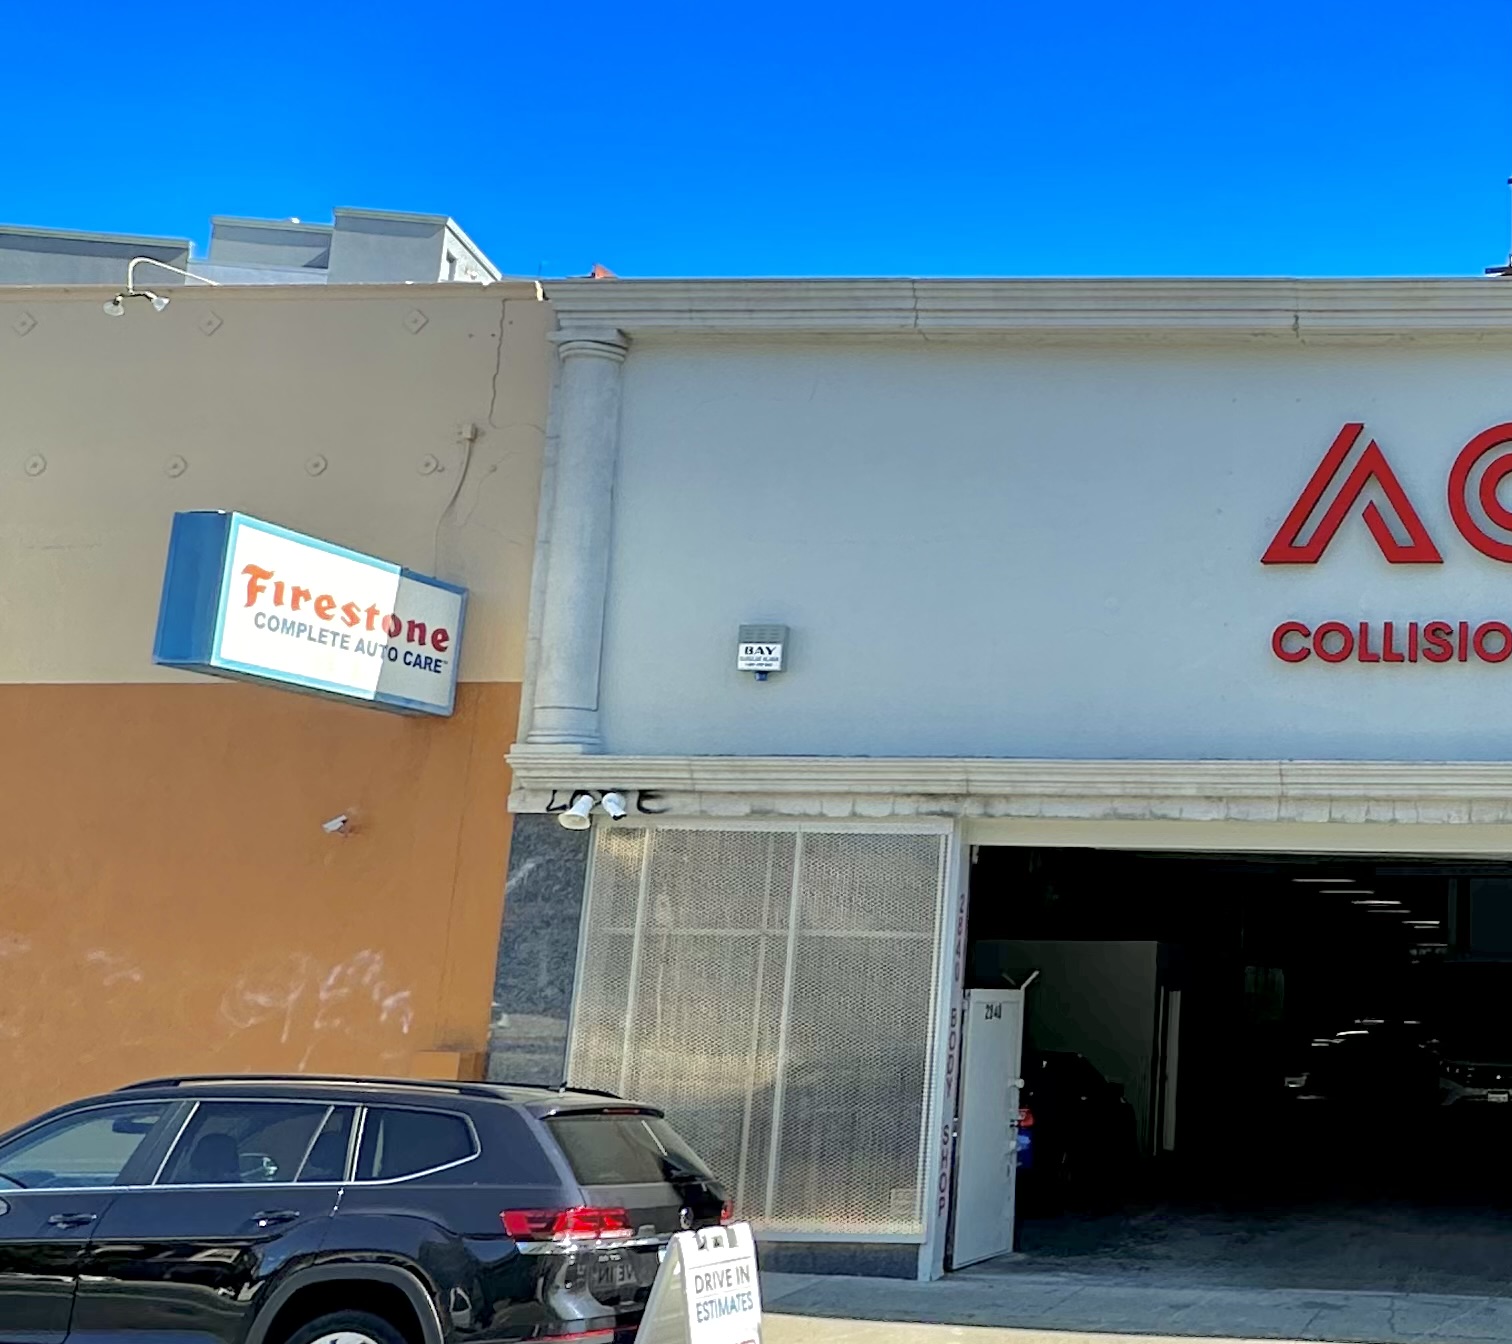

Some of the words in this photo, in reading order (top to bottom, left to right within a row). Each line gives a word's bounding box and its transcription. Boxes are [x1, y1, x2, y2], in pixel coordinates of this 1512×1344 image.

[241, 564, 450, 652] Firestone
[254, 612, 351, 650] COMPLETE
[354, 638, 398, 662] AUTO
[403, 651, 443, 674] CARE
[744, 646, 777, 655] BAY
[938, 1124, 950, 1217] SHOP
[694, 1268, 733, 1294] DRIVE
[735, 1265, 750, 1285] IN
[696, 1291, 754, 1323] ESTIMATES
